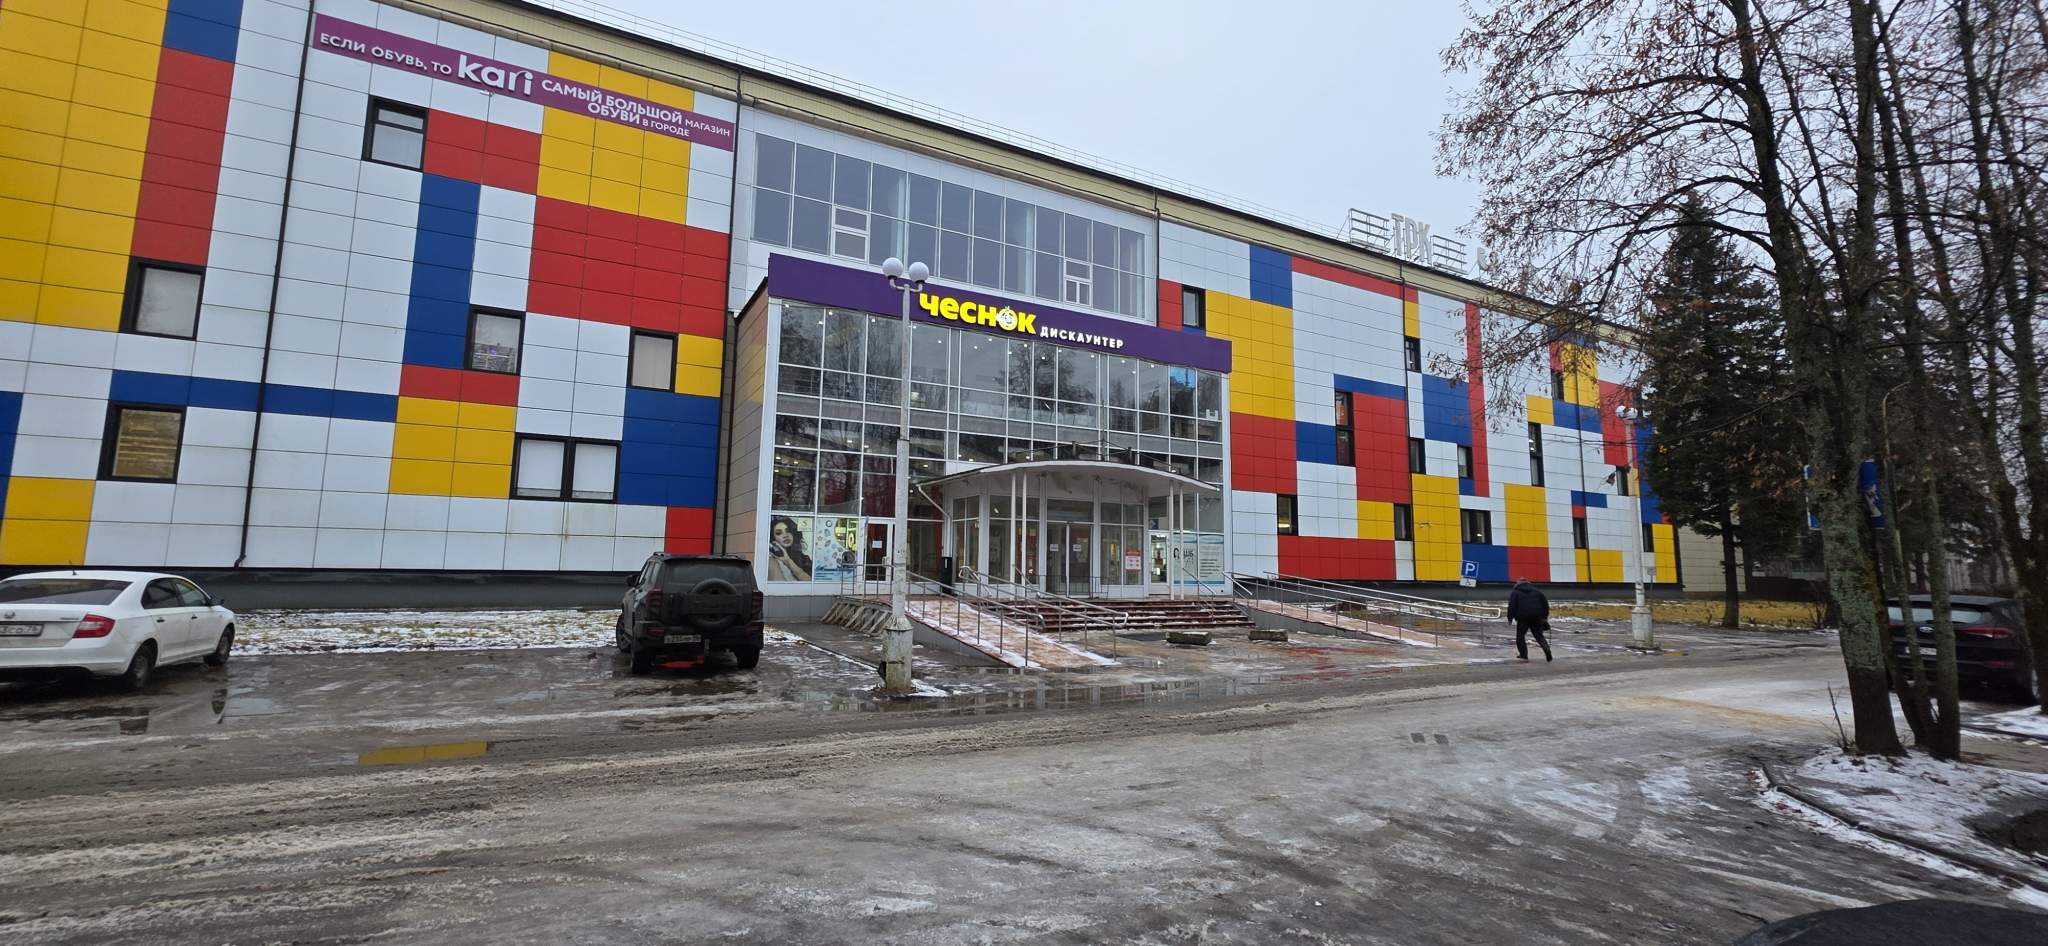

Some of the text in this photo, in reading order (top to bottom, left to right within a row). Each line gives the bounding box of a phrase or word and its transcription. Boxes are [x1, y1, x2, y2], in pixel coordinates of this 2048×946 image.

[320, 33, 366, 53] ЕСЛИ
[431, 61, 453, 75] ТО
[458, 54, 534, 95] kari
[541, 79, 602, 104] САМЫЙ
[606, 95, 683, 125] БОЛЬШОЙ
[685, 119, 731, 138] МАГАЗИН
[588, 102, 690, 137] ОБУВИ В ГОРОДЕ
[1391, 212, 1434, 267] ТРК
[1040, 326, 1124, 349] ДИСКАУНТЕР
